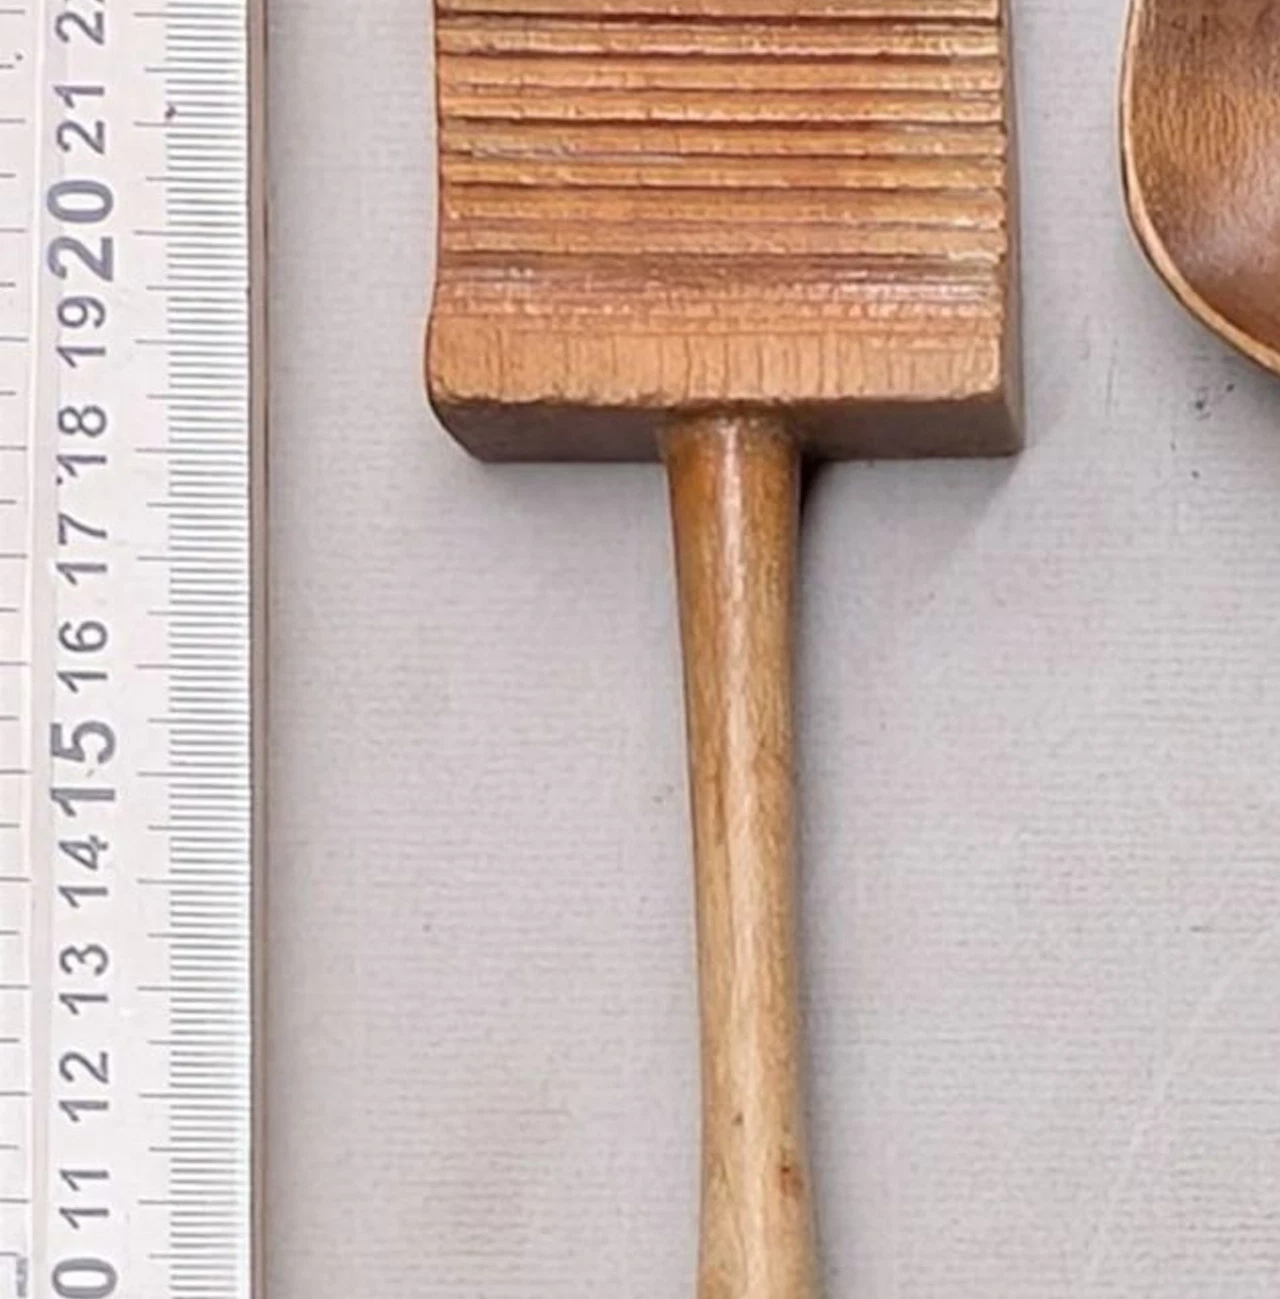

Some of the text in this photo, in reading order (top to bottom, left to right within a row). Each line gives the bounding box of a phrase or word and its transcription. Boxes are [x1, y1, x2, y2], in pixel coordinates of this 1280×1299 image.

[52, 85, 105, 155] 21
[43, 180, 114, 282] 20
[55, 296, 107, 368] 19
[56, 405, 108, 477] 18
[56, 512, 108, 585] 17
[56, 621, 108, 693] 16
[49, 721, 116, 817] 15
[58, 835, 109, 908] 14
[59, 944, 109, 1015] 13
[58, 1051, 109, 1123] 12
[59, 1169, 110, 1230] 11
